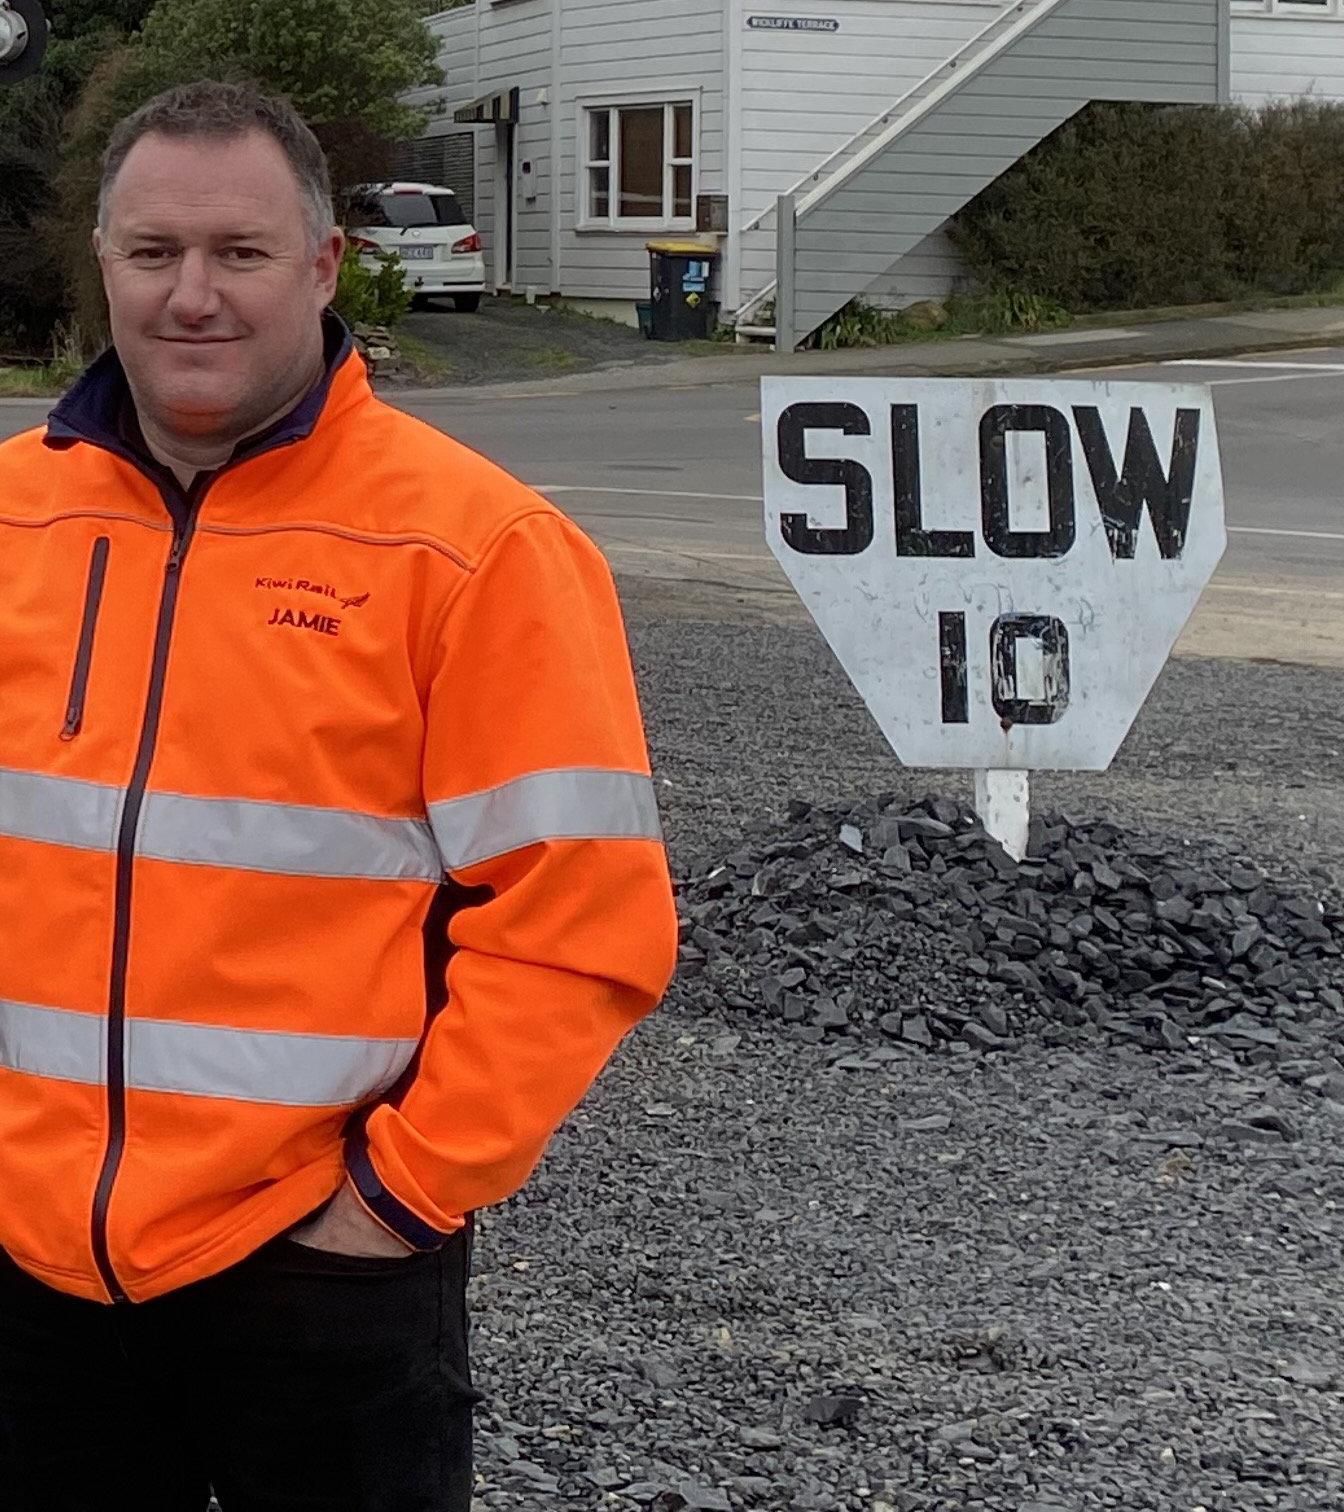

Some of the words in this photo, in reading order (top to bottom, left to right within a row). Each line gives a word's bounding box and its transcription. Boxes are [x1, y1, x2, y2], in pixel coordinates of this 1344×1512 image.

[797, 19, 836, 31] TERRACE
[777, 401, 1201, 562] SLOW
[268, 608, 341, 636] JAMIE
[938, 610, 1072, 725] 10
